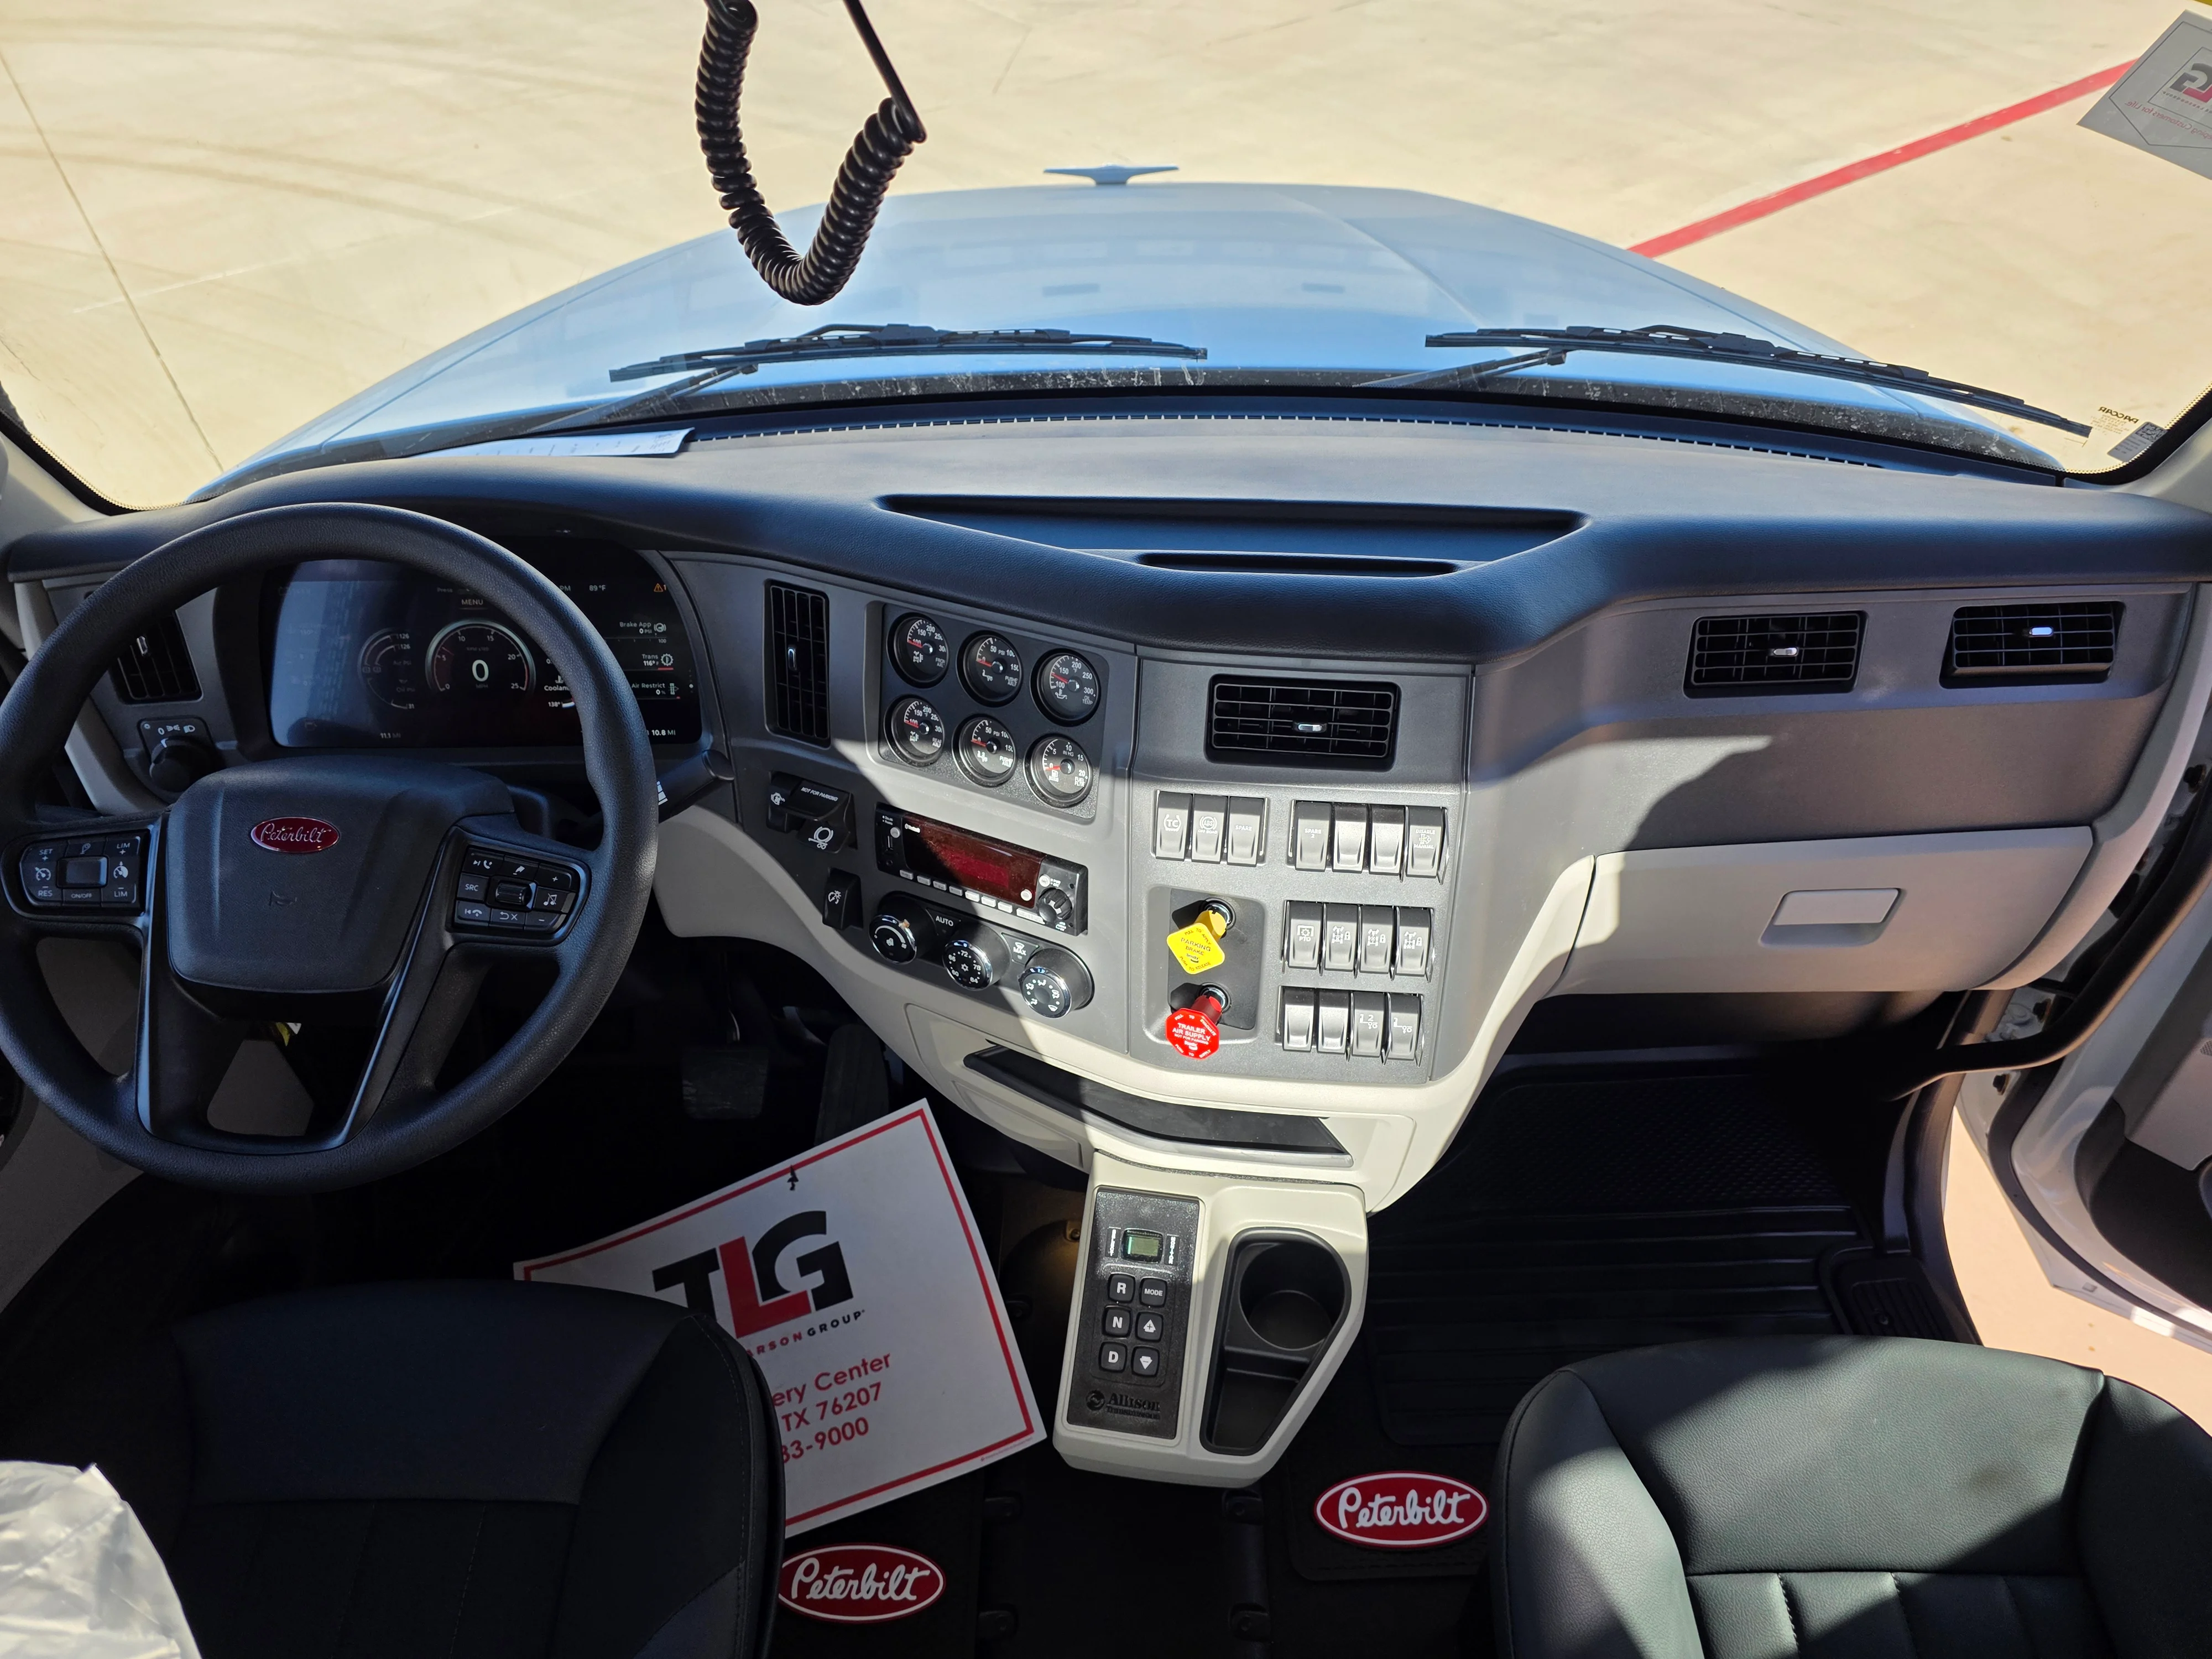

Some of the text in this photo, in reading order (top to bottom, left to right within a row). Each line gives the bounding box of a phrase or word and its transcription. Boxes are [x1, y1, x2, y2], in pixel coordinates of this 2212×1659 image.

[926, 624, 935, 633] 200
[472, 659, 489, 682] 0
[1071, 661, 1082, 669] 200
[1082, 671, 1093, 680] 250
[1084, 687, 1094, 695] 300
[922, 706, 932, 714] 200
[819, 792, 838, 801] PARKING
[1166, 820, 1178, 828] TC
[260, 823, 332, 842] Peterbilt
[465, 883, 479, 891] SRC
[936, 915, 954, 927] AUTO
[1181, 937, 1211, 952] PARKING
[1013, 947, 1027, 956] MAX
[1185, 946, 1204, 956] BRAKE
[1177, 1022, 1206, 1035] TRAILER
[1185, 1030, 1211, 1041] SUPPLY
[652, 1211, 853, 1339] TLG
[1116, 1282, 1127, 1295] R
[1144, 1288, 1164, 1297] MODE
[1112, 1316, 1123, 1329] N
[1108, 1350, 1119, 1364] D
[814, 1353, 891, 1391] Center
[781, 1381, 881, 1432] TX 76207
[1108, 1392, 1161, 1411] Allison
[1337, 1485, 1471, 1528] Peterbilt
[791, 1557, 931, 1601] Peterbilt
